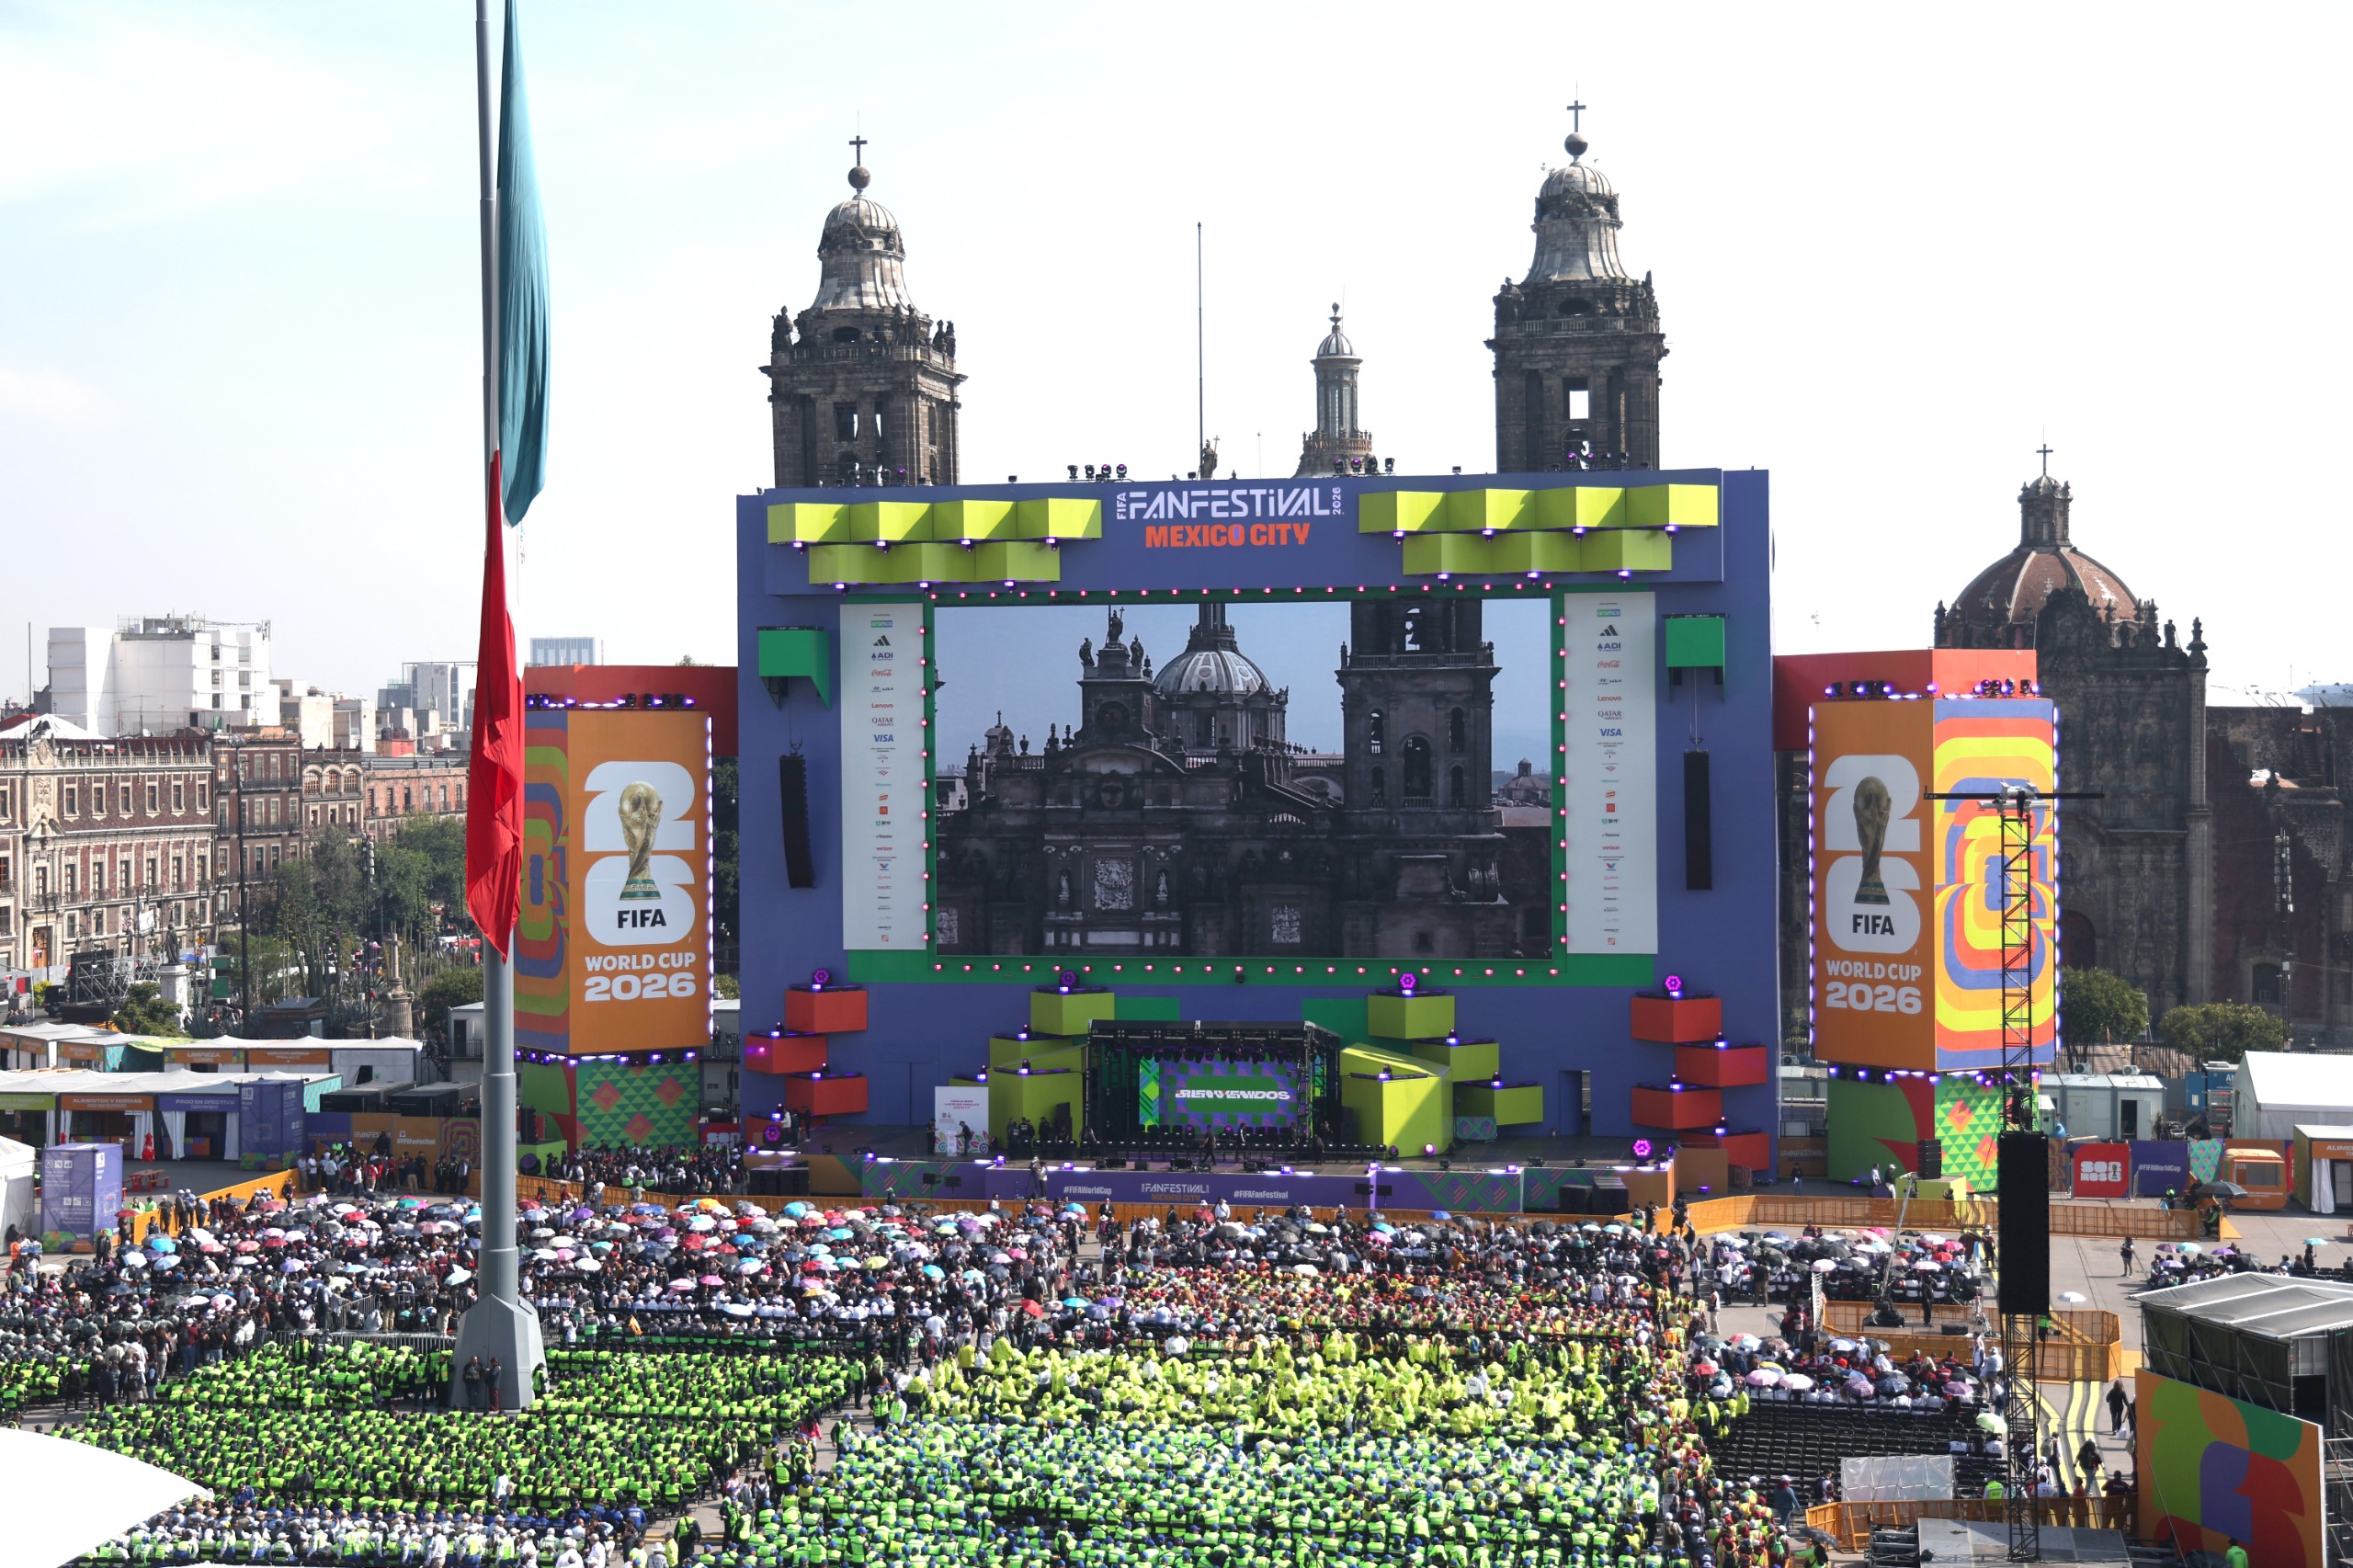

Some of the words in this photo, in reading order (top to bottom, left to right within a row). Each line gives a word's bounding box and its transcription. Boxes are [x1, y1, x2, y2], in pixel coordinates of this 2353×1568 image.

[1116, 492, 1127, 520] FIFA
[1332, 486, 1342, 516] 2026
[1145, 523, 1245, 549] MEXICO
[1249, 522, 1311, 547] CITY
[873, 734, 894, 743] VISA
[1599, 728, 1622, 736] VISA
[617, 908, 667, 929] FIFA
[1852, 914, 1895, 936] FIFA
[585, 954, 655, 972] WORLD
[658, 952, 697, 969] CUP
[1825, 960, 1886, 980] WORLD
[1887, 963, 1922, 982] CUP
[585, 971, 697, 1002] 2026
[1825, 981, 1922, 1015] 2026
[1175, 1089, 1290, 1100] BIENVENIDOS
[2138, 1164, 2181, 1173] #FIFAWorldCup
[1063, 1186, 1112, 1196] #FIFAWorldCup
[1152, 1193, 1182, 1201] MEXICO
[1183, 1194, 1201, 1202] CITY
[1233, 1189, 1289, 1199] #FIFAFanFestival
